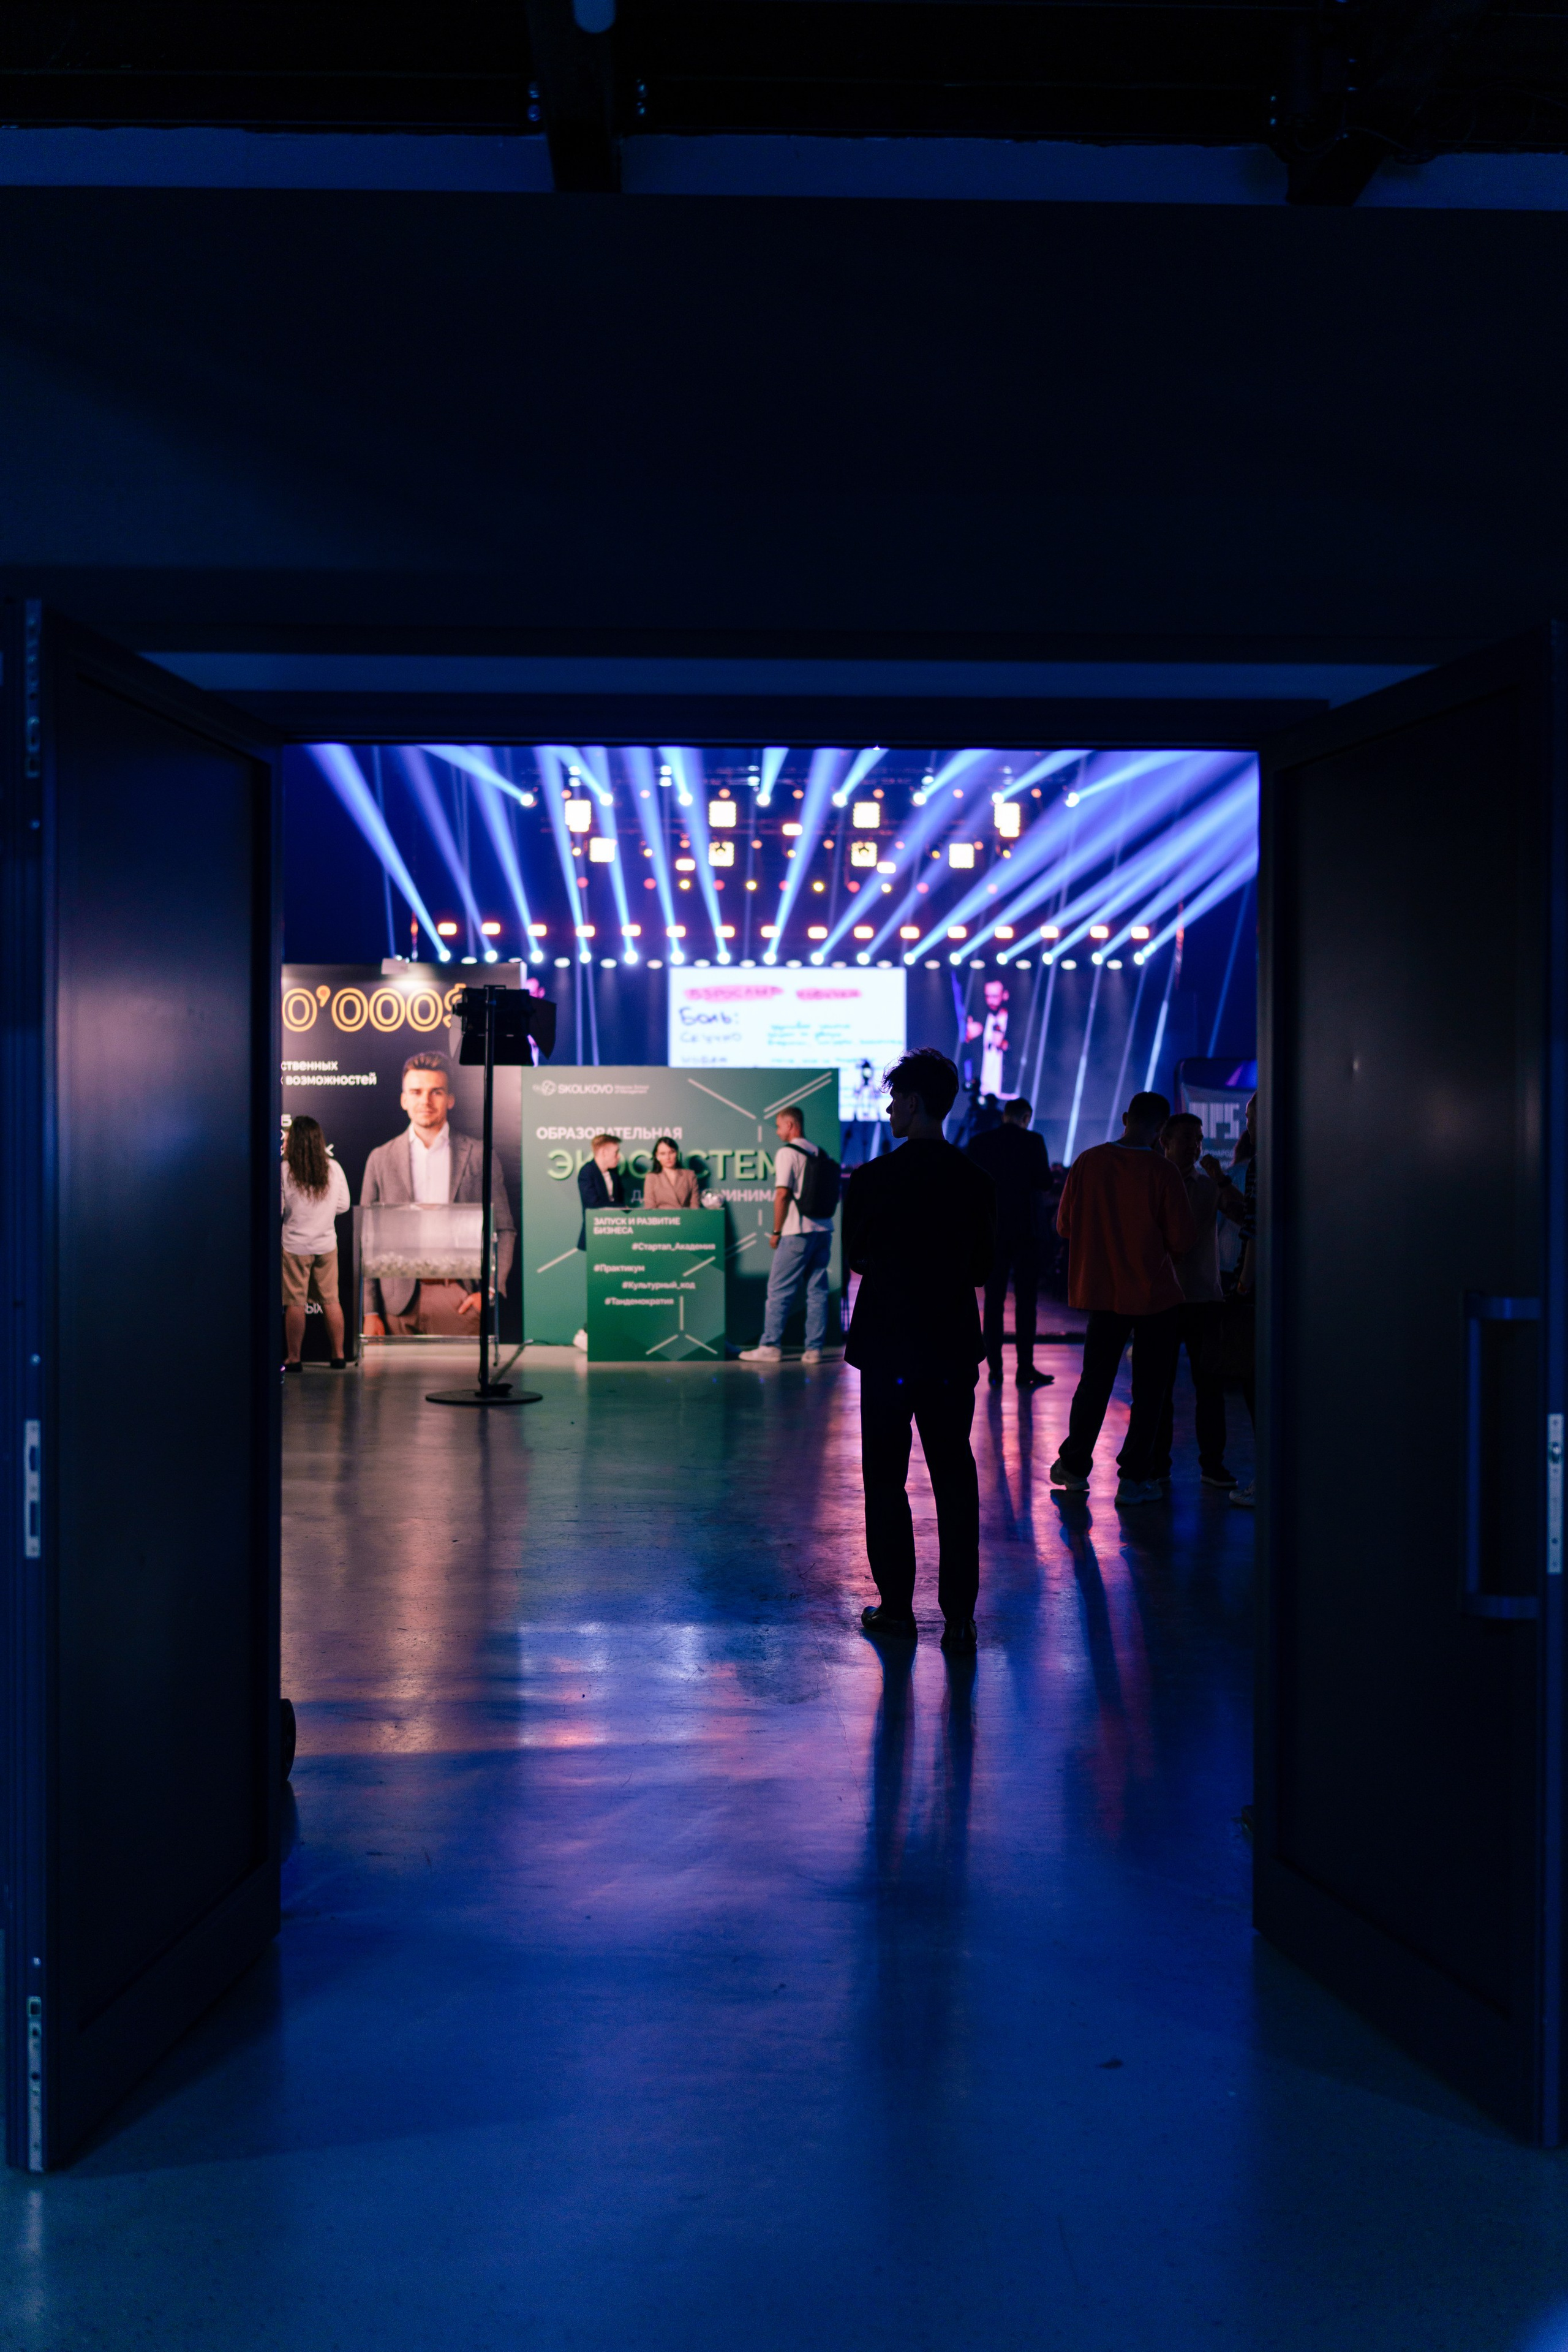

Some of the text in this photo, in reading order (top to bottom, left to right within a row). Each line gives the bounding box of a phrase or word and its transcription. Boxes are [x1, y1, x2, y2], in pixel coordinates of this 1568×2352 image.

[286, 1072, 377, 1085] возможностей
[558, 1084, 613, 1094] SKOLKOVO
[632, 1243, 715, 1251] #Стартап_Академия
[594, 1264, 645, 1273] #Практикум
[622, 1281, 696, 1291] #Культурный_код
[605, 1297, 674, 1306] #Тандемократия
